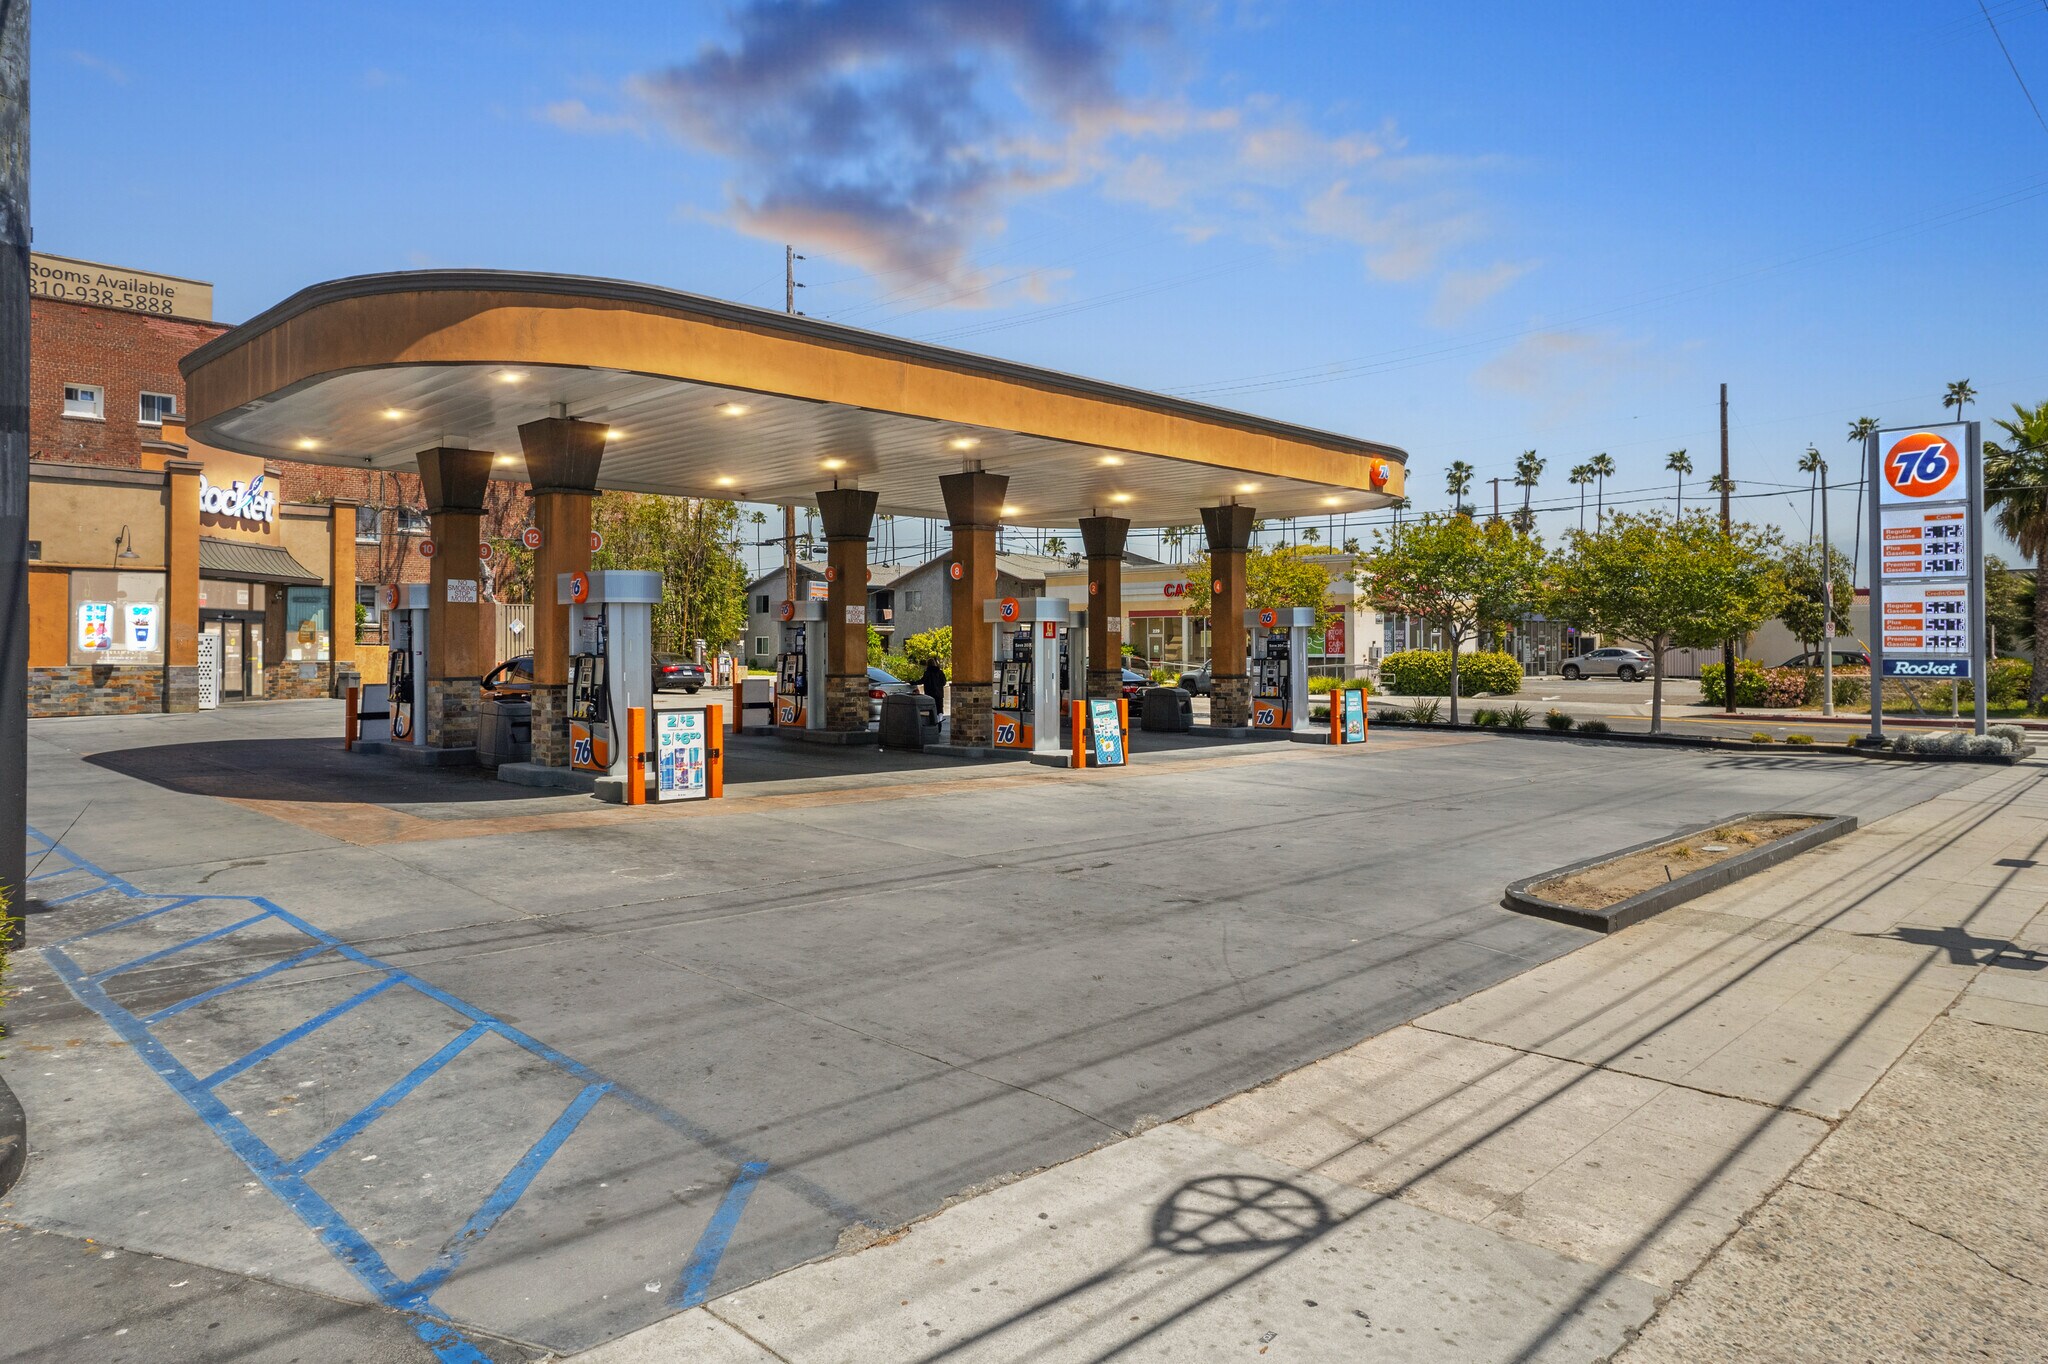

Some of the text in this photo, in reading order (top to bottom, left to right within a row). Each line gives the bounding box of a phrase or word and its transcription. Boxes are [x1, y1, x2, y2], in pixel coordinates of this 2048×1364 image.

[96, 274, 175, 298] Available
[1892, 442, 1949, 487] 76
[527, 534, 539, 544] 12
[422, 545, 433, 553] 10
[481, 547, 488, 555] 9
[1001, 603, 1014, 617] 76
[1261, 612, 1273, 623] 76
[1893, 661, 1958, 675] Rocket
[667, 714, 695, 728] 2/$5
[781, 706, 794, 723] 76
[1257, 708, 1274, 725] 76
[997, 723, 1015, 744] 76
[574, 738, 591, 764] 76
